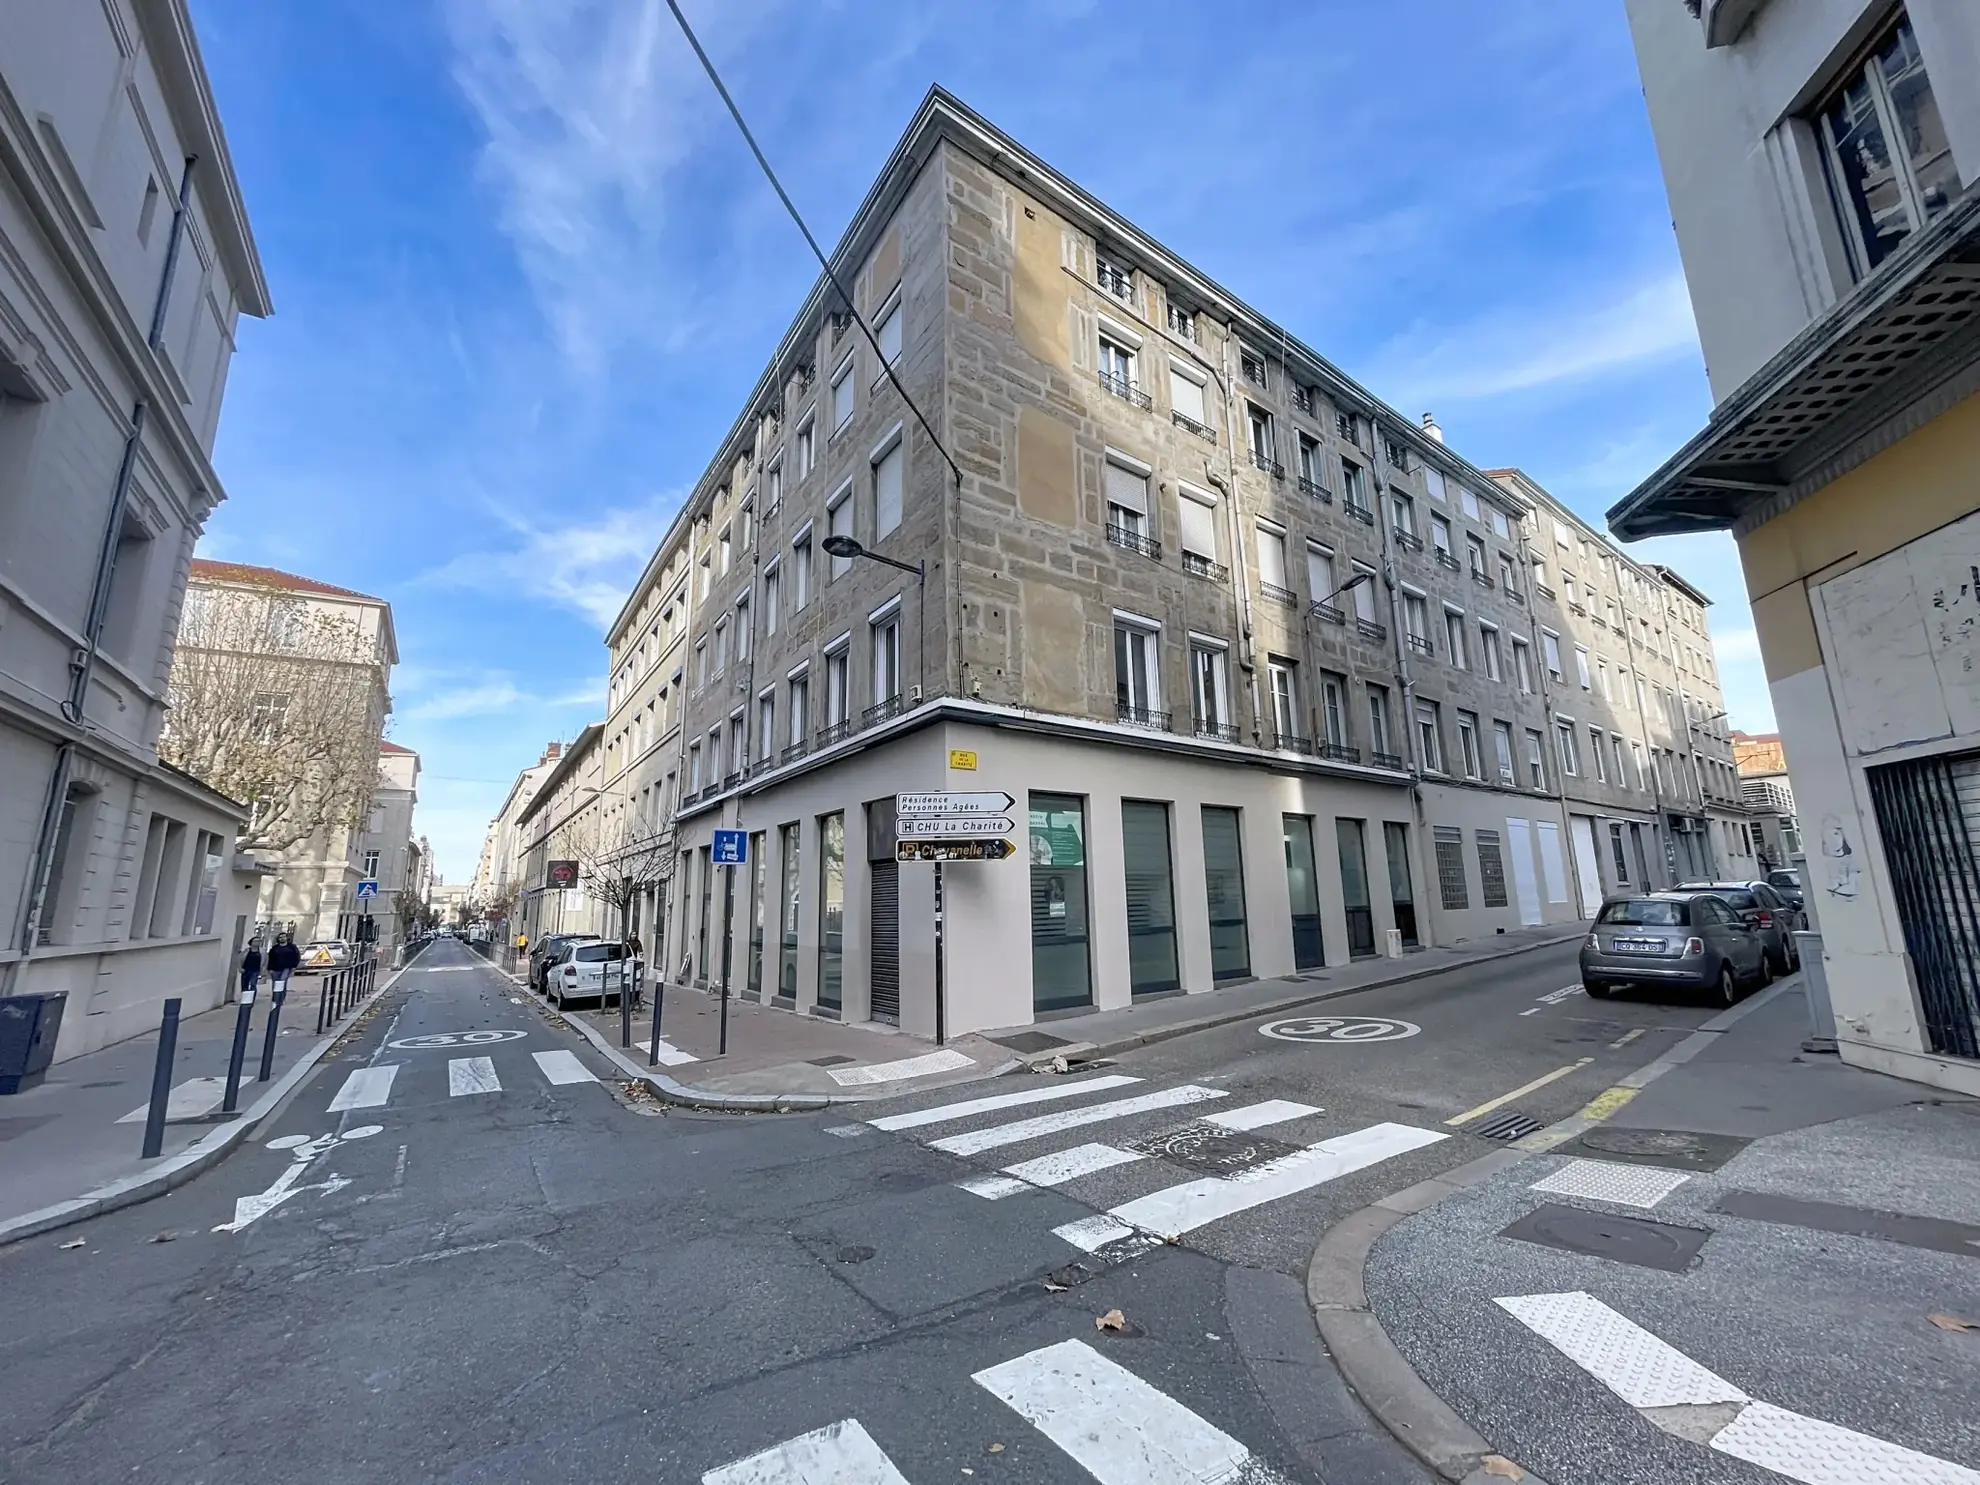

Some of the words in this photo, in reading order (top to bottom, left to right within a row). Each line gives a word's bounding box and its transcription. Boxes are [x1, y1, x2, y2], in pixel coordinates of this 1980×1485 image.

[953, 803, 980, 812] Agées
[917, 822, 940, 831] CHU
[945, 822, 956, 831] La
[962, 821, 1003, 830] Charité
[921, 844, 983, 856] Chvanelle
[1279, 1020, 1395, 1039] 30
[415, 1032, 504, 1046] 30
